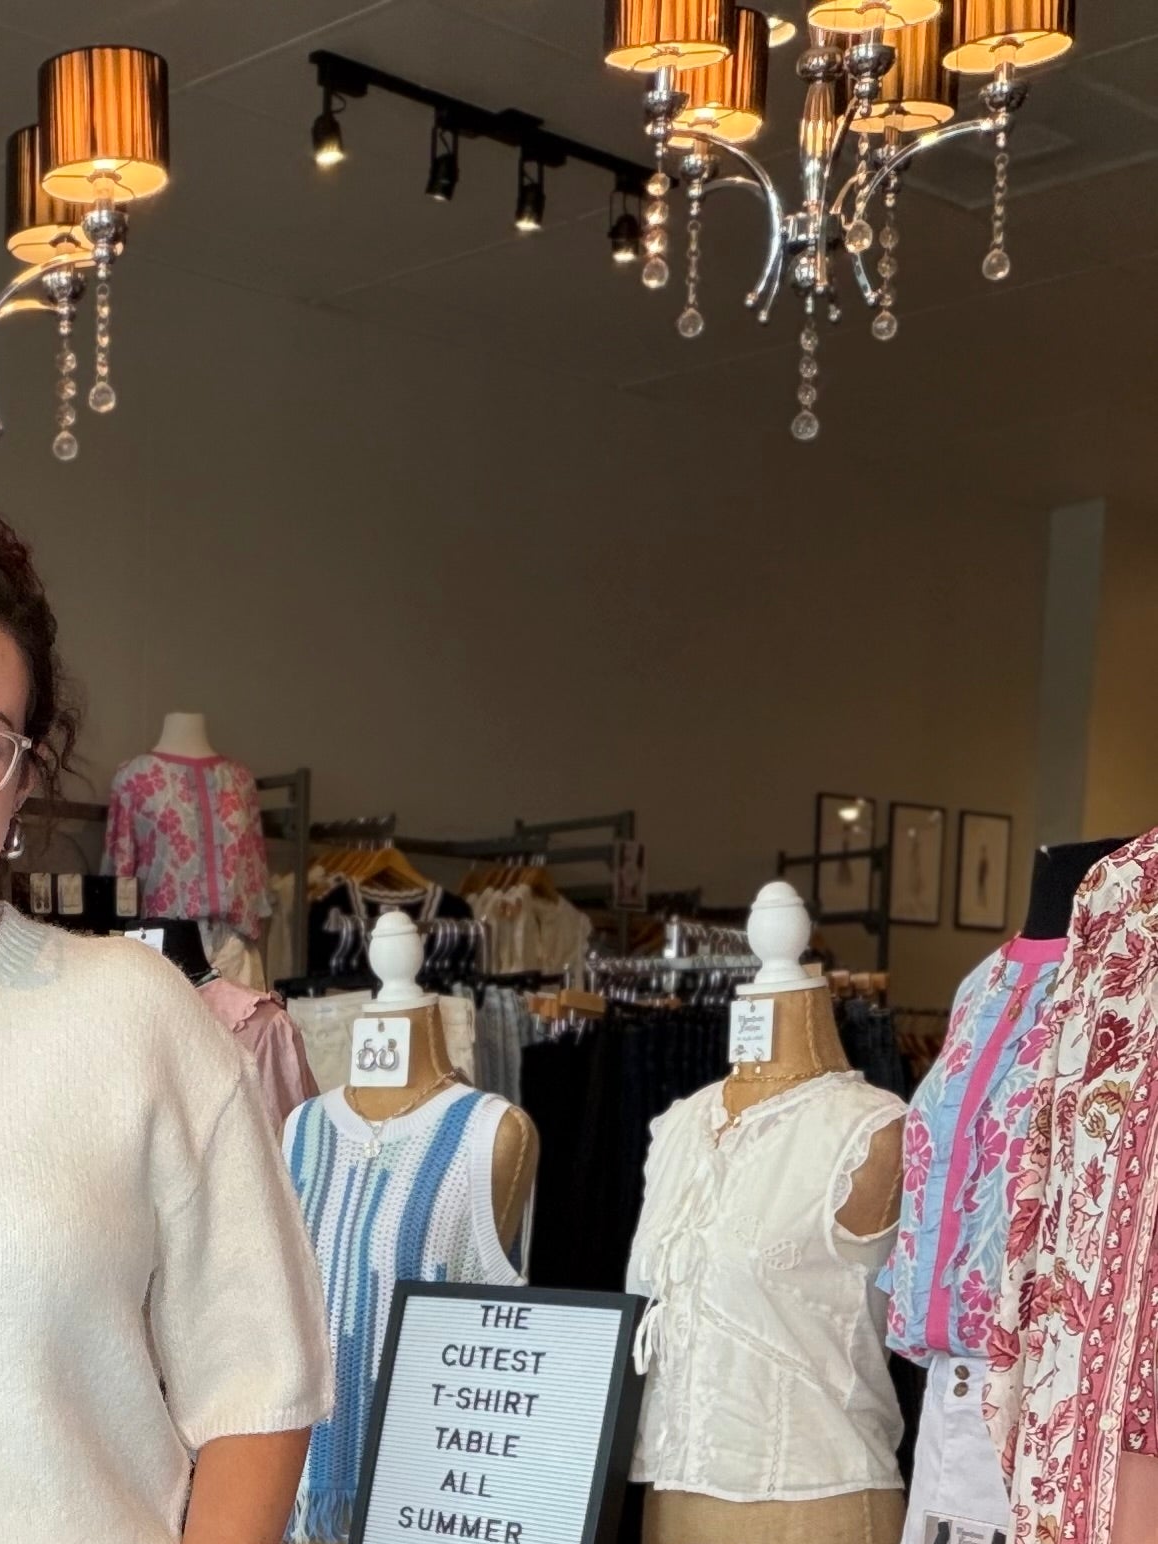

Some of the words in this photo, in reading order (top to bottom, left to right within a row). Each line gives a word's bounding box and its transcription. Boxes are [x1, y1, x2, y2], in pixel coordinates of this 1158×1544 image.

[480, 1304, 532, 1329] THE
[441, 1344, 546, 1374] CUTEST
[432, 1383, 539, 1417] T-SHIRT
[435, 1426, 520, 1458] TABLE
[439, 1468, 492, 1498] ALL
[398, 1506, 523, 1544] SUMMER
